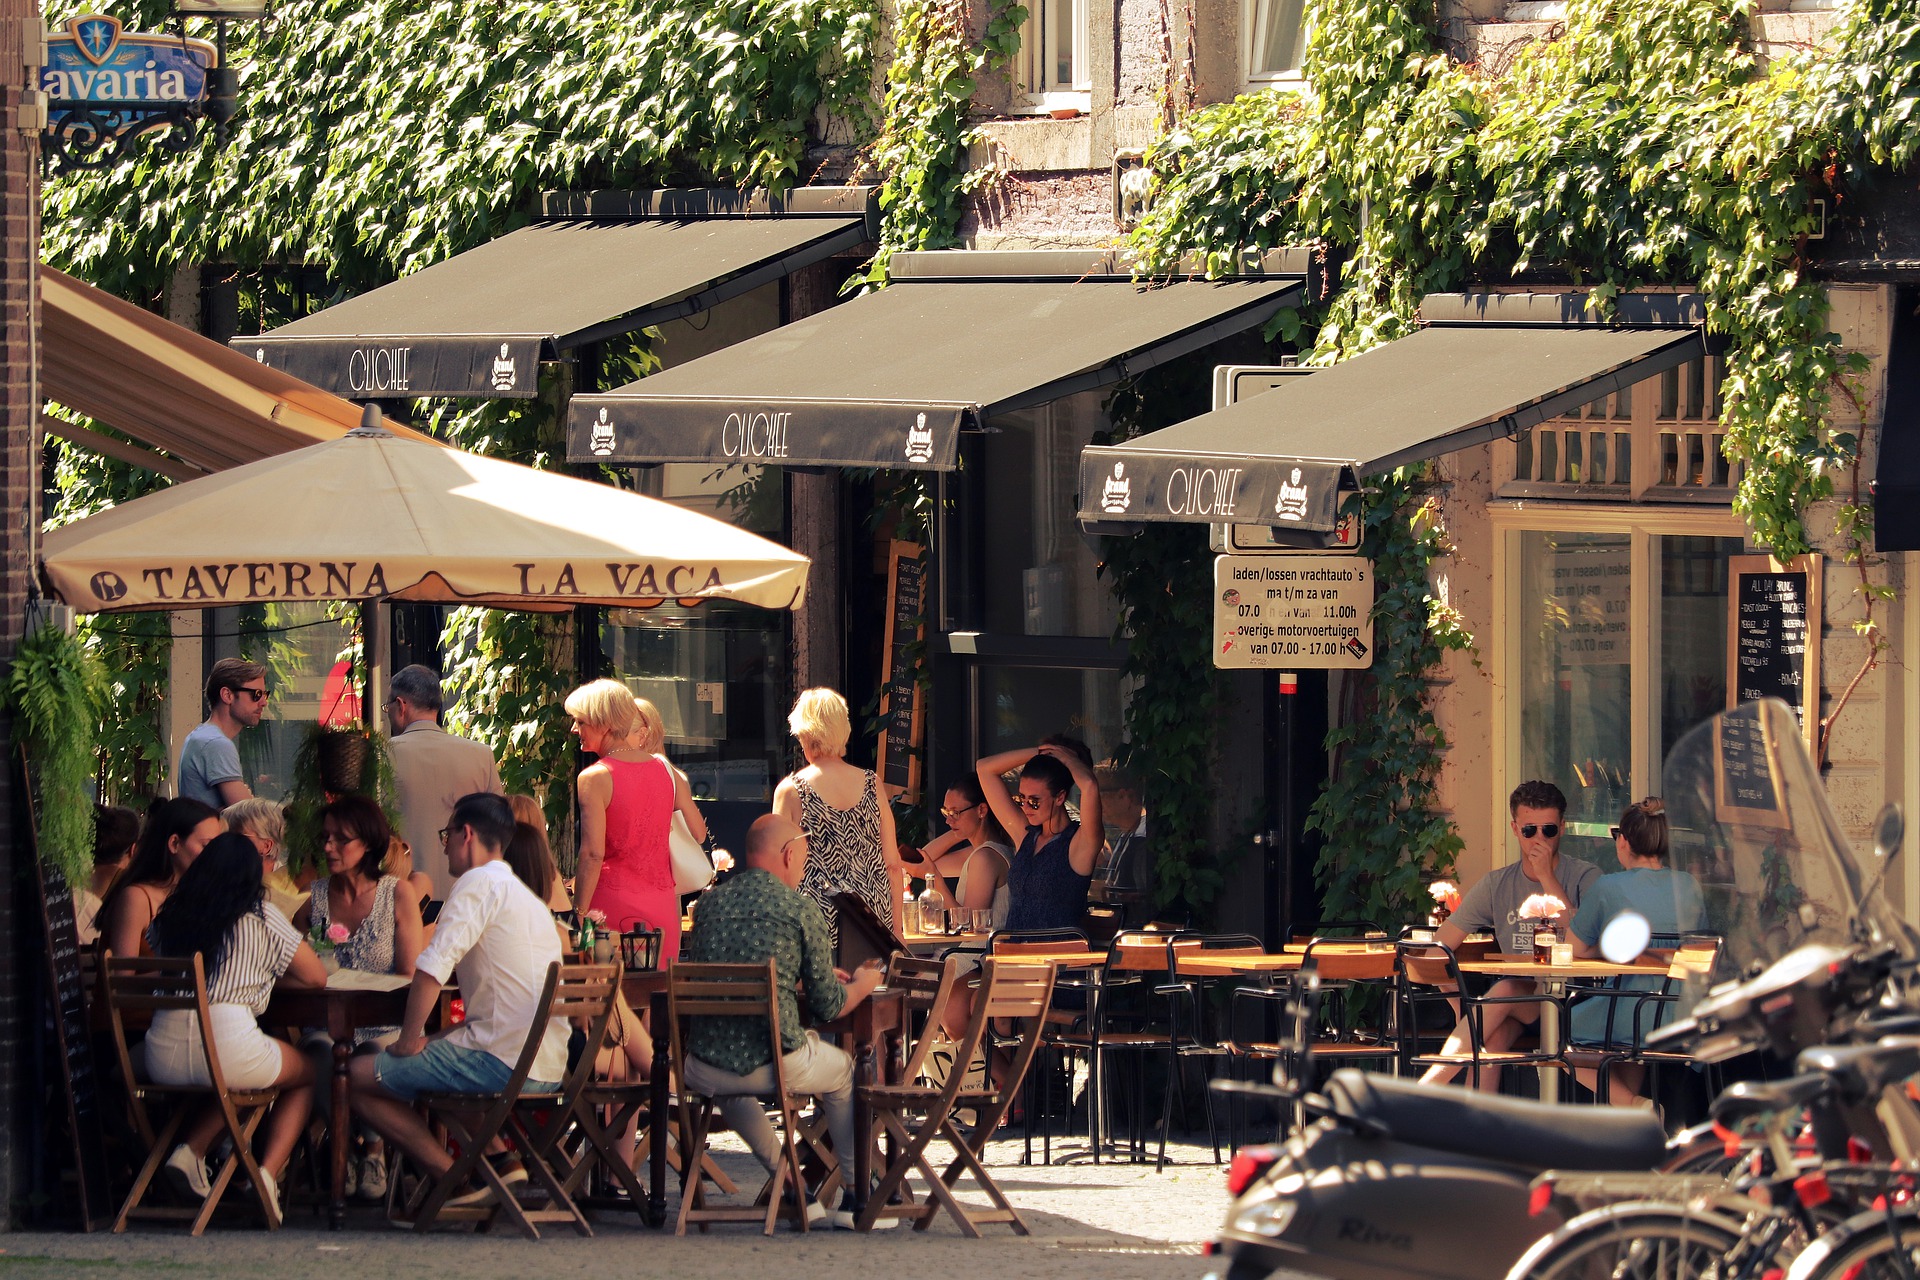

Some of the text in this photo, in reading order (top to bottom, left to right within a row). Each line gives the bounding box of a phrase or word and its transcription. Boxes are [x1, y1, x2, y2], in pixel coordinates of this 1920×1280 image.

[43, 60, 187, 100] avaria
[349, 348, 410, 391] CLICHEE
[722, 412, 791, 457] CLICHEE
[1167, 468, 1242, 516] CLICHEE
[142, 561, 732, 599] TAVERNA LA VACA
[1233, 567, 1297, 582] laden/lossen
[1267, 586, 1338, 601] ma t/m za van
[1323, 605, 1356, 618] 11.00h
[1238, 622, 1359, 639] overige motorvoertuigen
[1250, 644, 1268, 654] van
[1271, 642, 1299, 655] 07.00
[1309, 642, 1337, 655] 17.00
[1340, 642, 1346, 655] h
